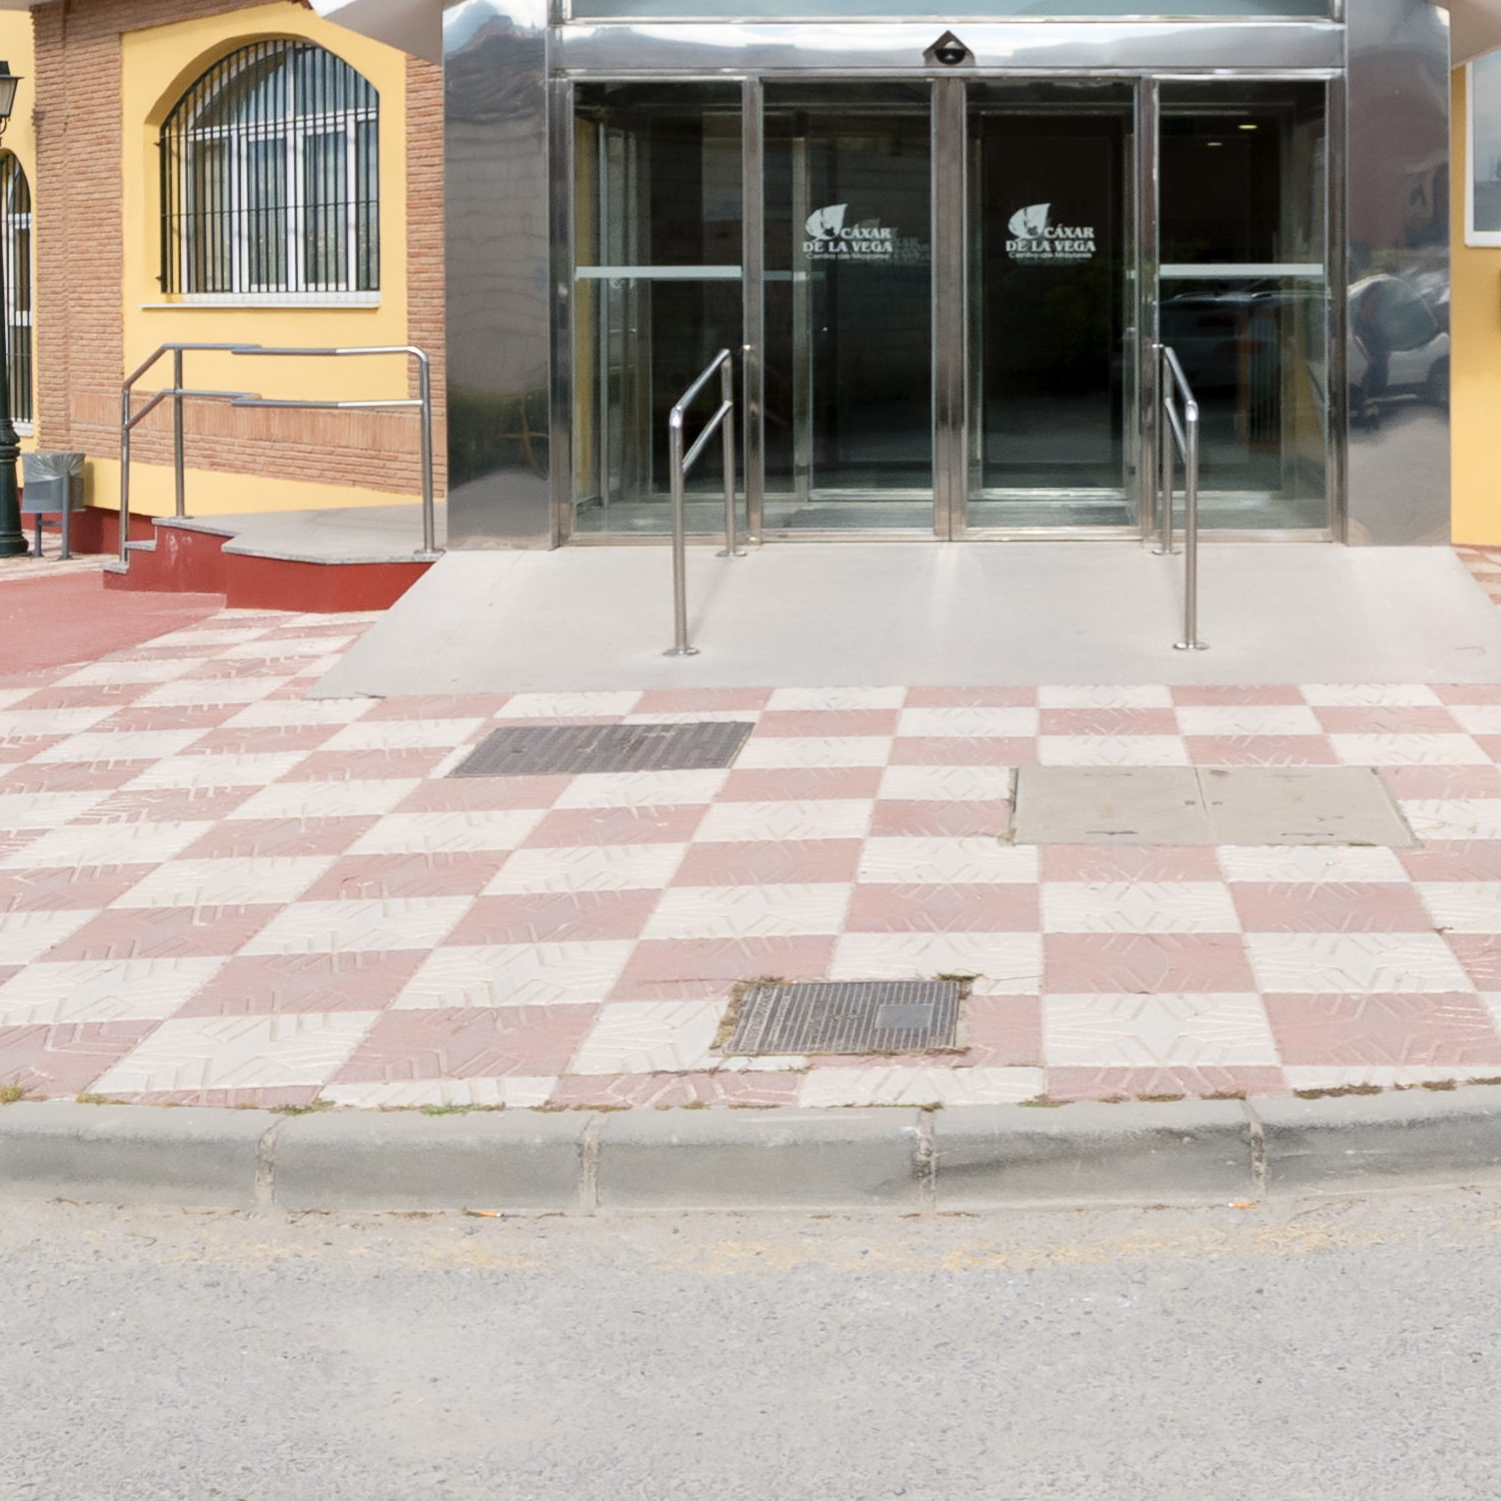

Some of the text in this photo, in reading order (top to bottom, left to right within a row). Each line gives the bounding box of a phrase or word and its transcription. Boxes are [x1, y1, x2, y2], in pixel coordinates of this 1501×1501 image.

[840, 223, 892, 239] CÁXAR
[1043, 223, 1095, 239] CÁXAR
[802, 241, 893, 252] DE LA VEGA
[1005, 240, 1096, 252] DE LA VEGA
